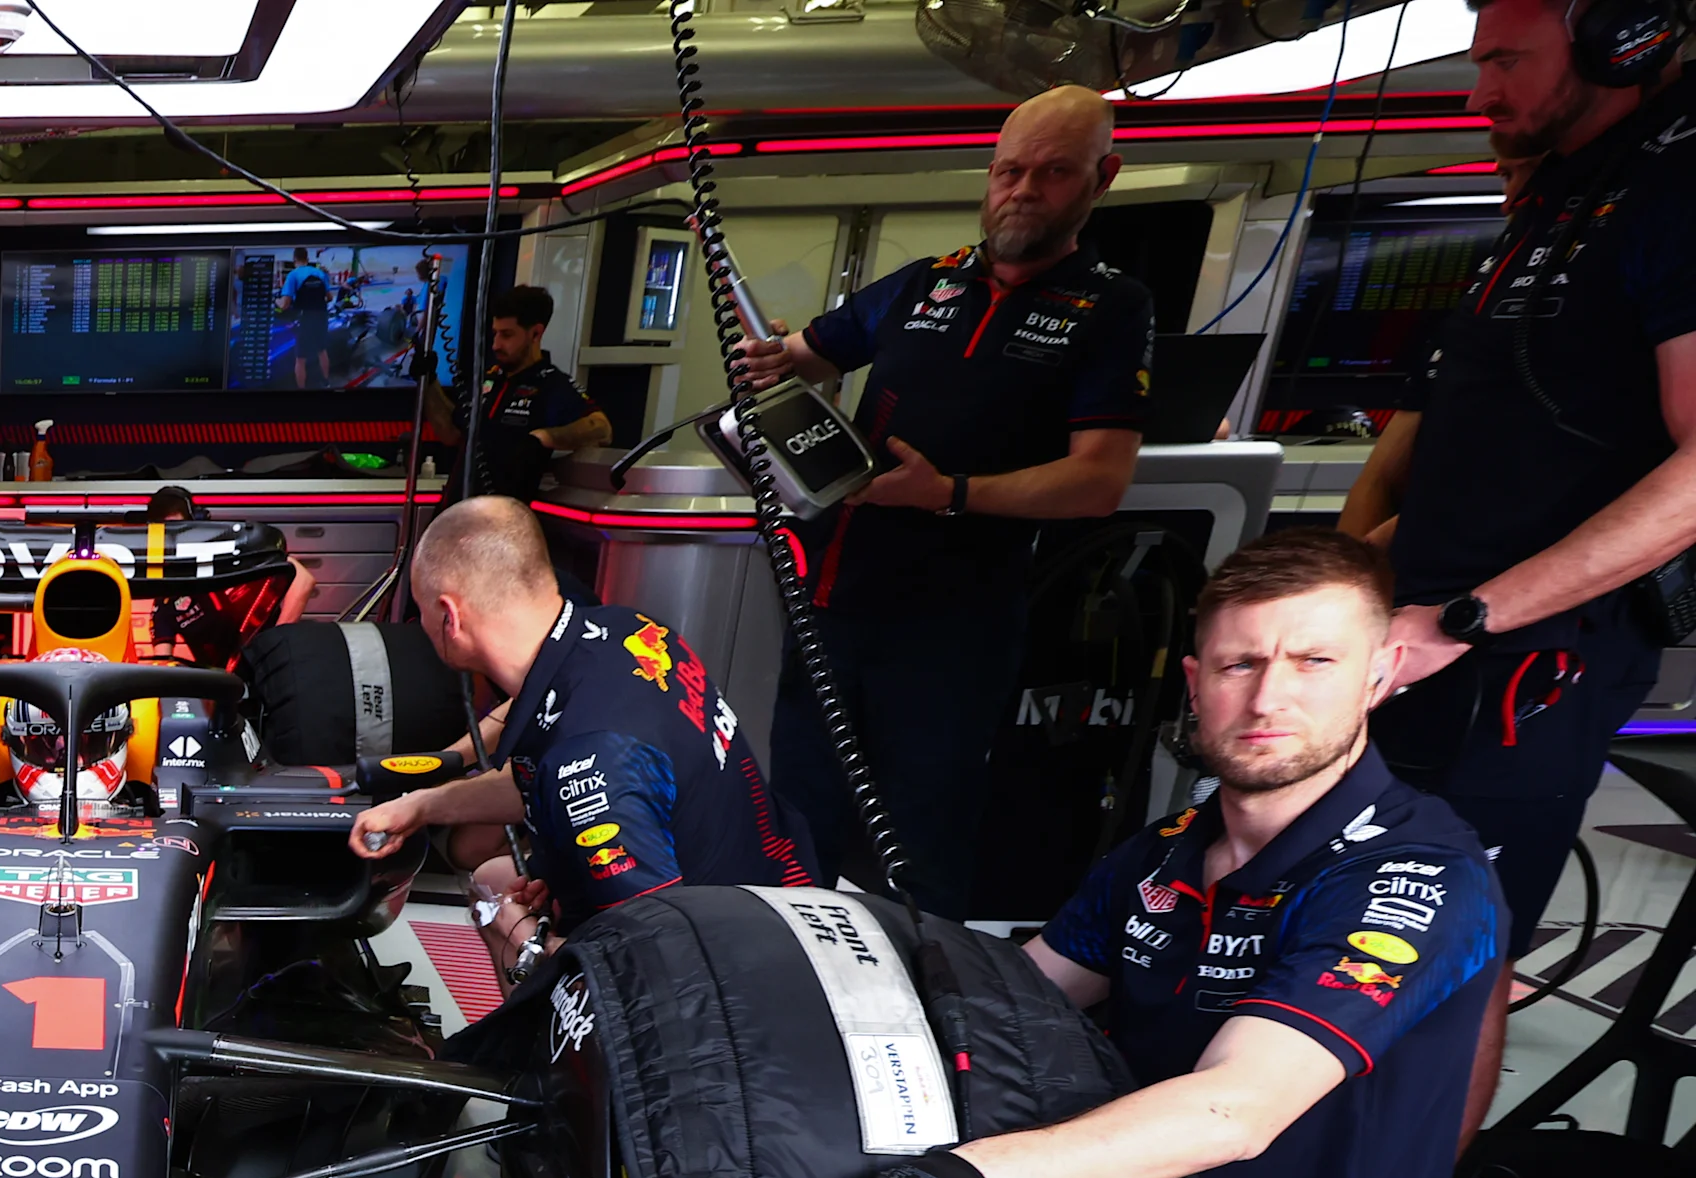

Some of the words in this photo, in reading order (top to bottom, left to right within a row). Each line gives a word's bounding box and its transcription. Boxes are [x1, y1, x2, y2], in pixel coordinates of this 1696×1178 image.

[1509, 274, 1570, 288] HOA
[1024, 312, 1078, 335] BYBIT
[1013, 329, 1070, 345] HONDA
[785, 418, 841, 456] ORACLE
[361, 684, 375, 716] Left
[373, 685, 385, 722] Rear
[1016, 688, 1137, 726] Mbi
[29, 722, 103, 736] ORALE
[163, 757, 206, 768] inter.mx
[557, 754, 596, 780] telcel
[559, 771, 607, 801] citrix
[263, 811, 353, 819] Walmart
[0, 869, 126, 885] TAG
[609, 856, 637, 876] Bull
[1376, 860, 1446, 877] telcel
[1367, 876, 1447, 907] citrix
[793, 902, 838, 947] Left
[818, 904, 879, 968] Front
[1125, 917, 1154, 940] bil
[1122, 945, 1152, 968] CLE
[1, 976, 106, 1050] 1
[58, 1080, 119, 1098] App
[885, 1042, 917, 1136] VERSTAPPEN
